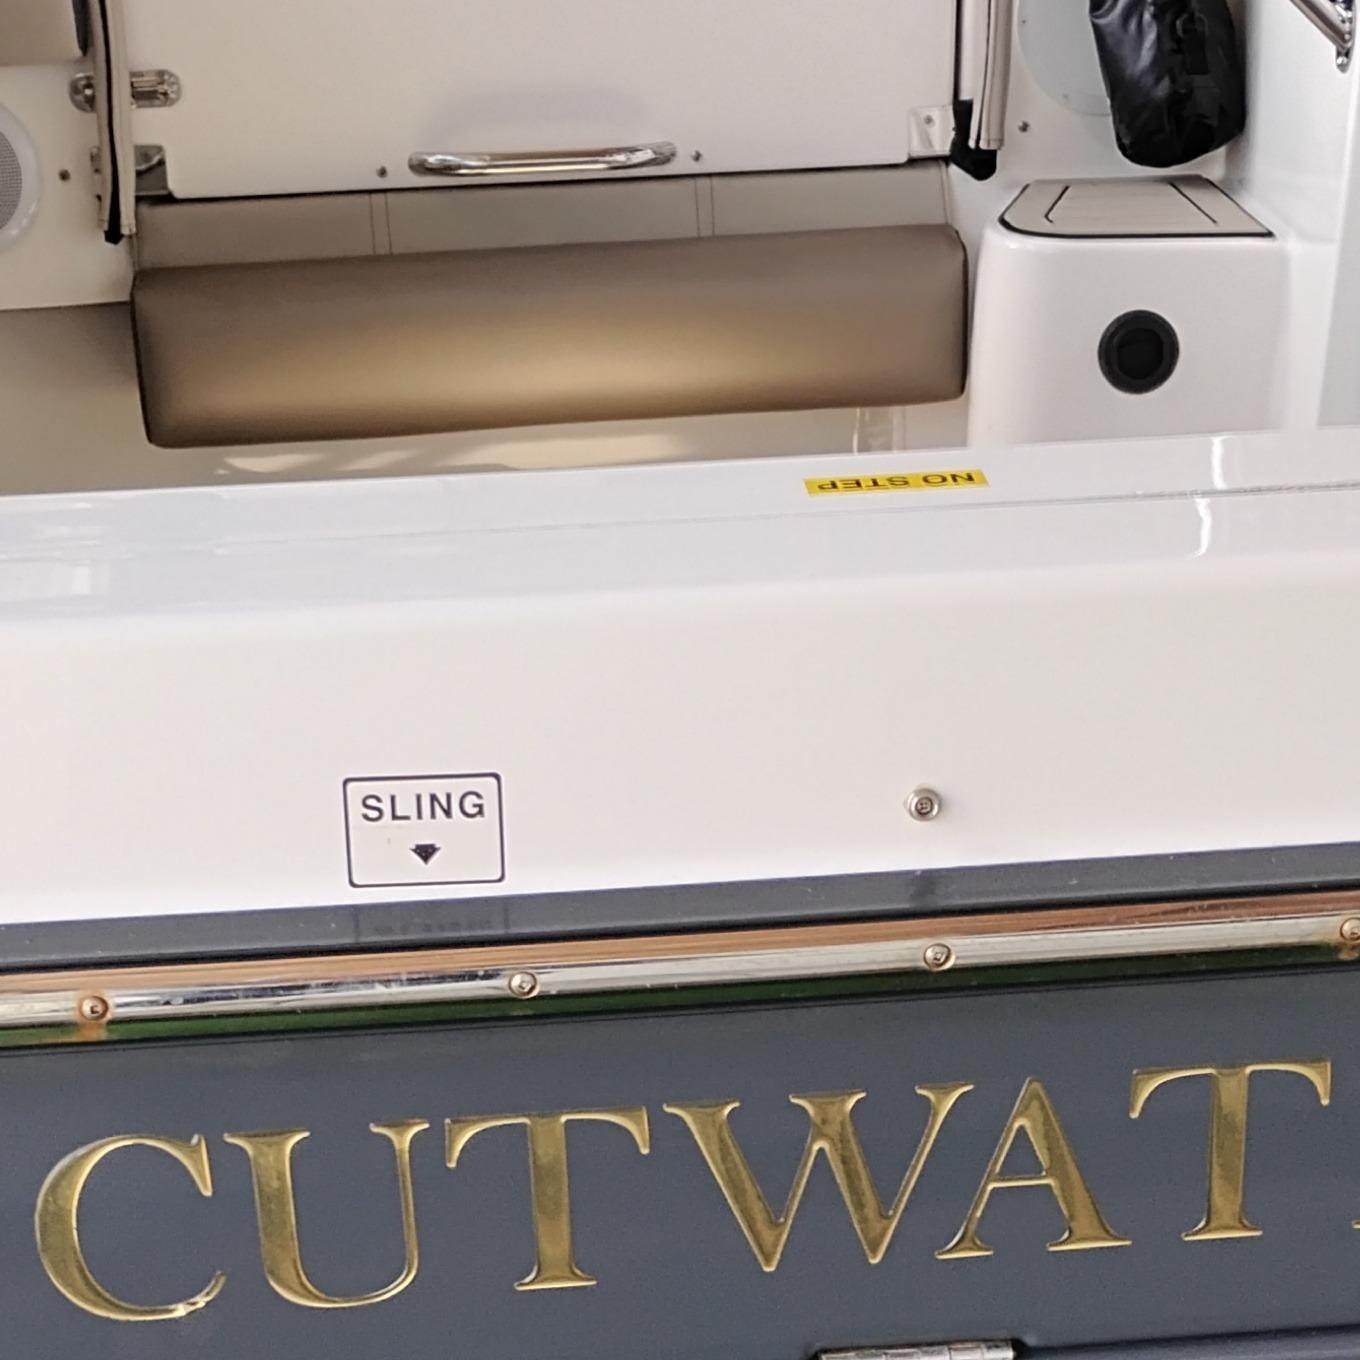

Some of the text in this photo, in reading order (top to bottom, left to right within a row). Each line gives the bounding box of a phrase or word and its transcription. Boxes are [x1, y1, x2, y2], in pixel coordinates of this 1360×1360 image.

[817, 472, 975, 490] NO STEP
[361, 790, 485, 822] SLING
